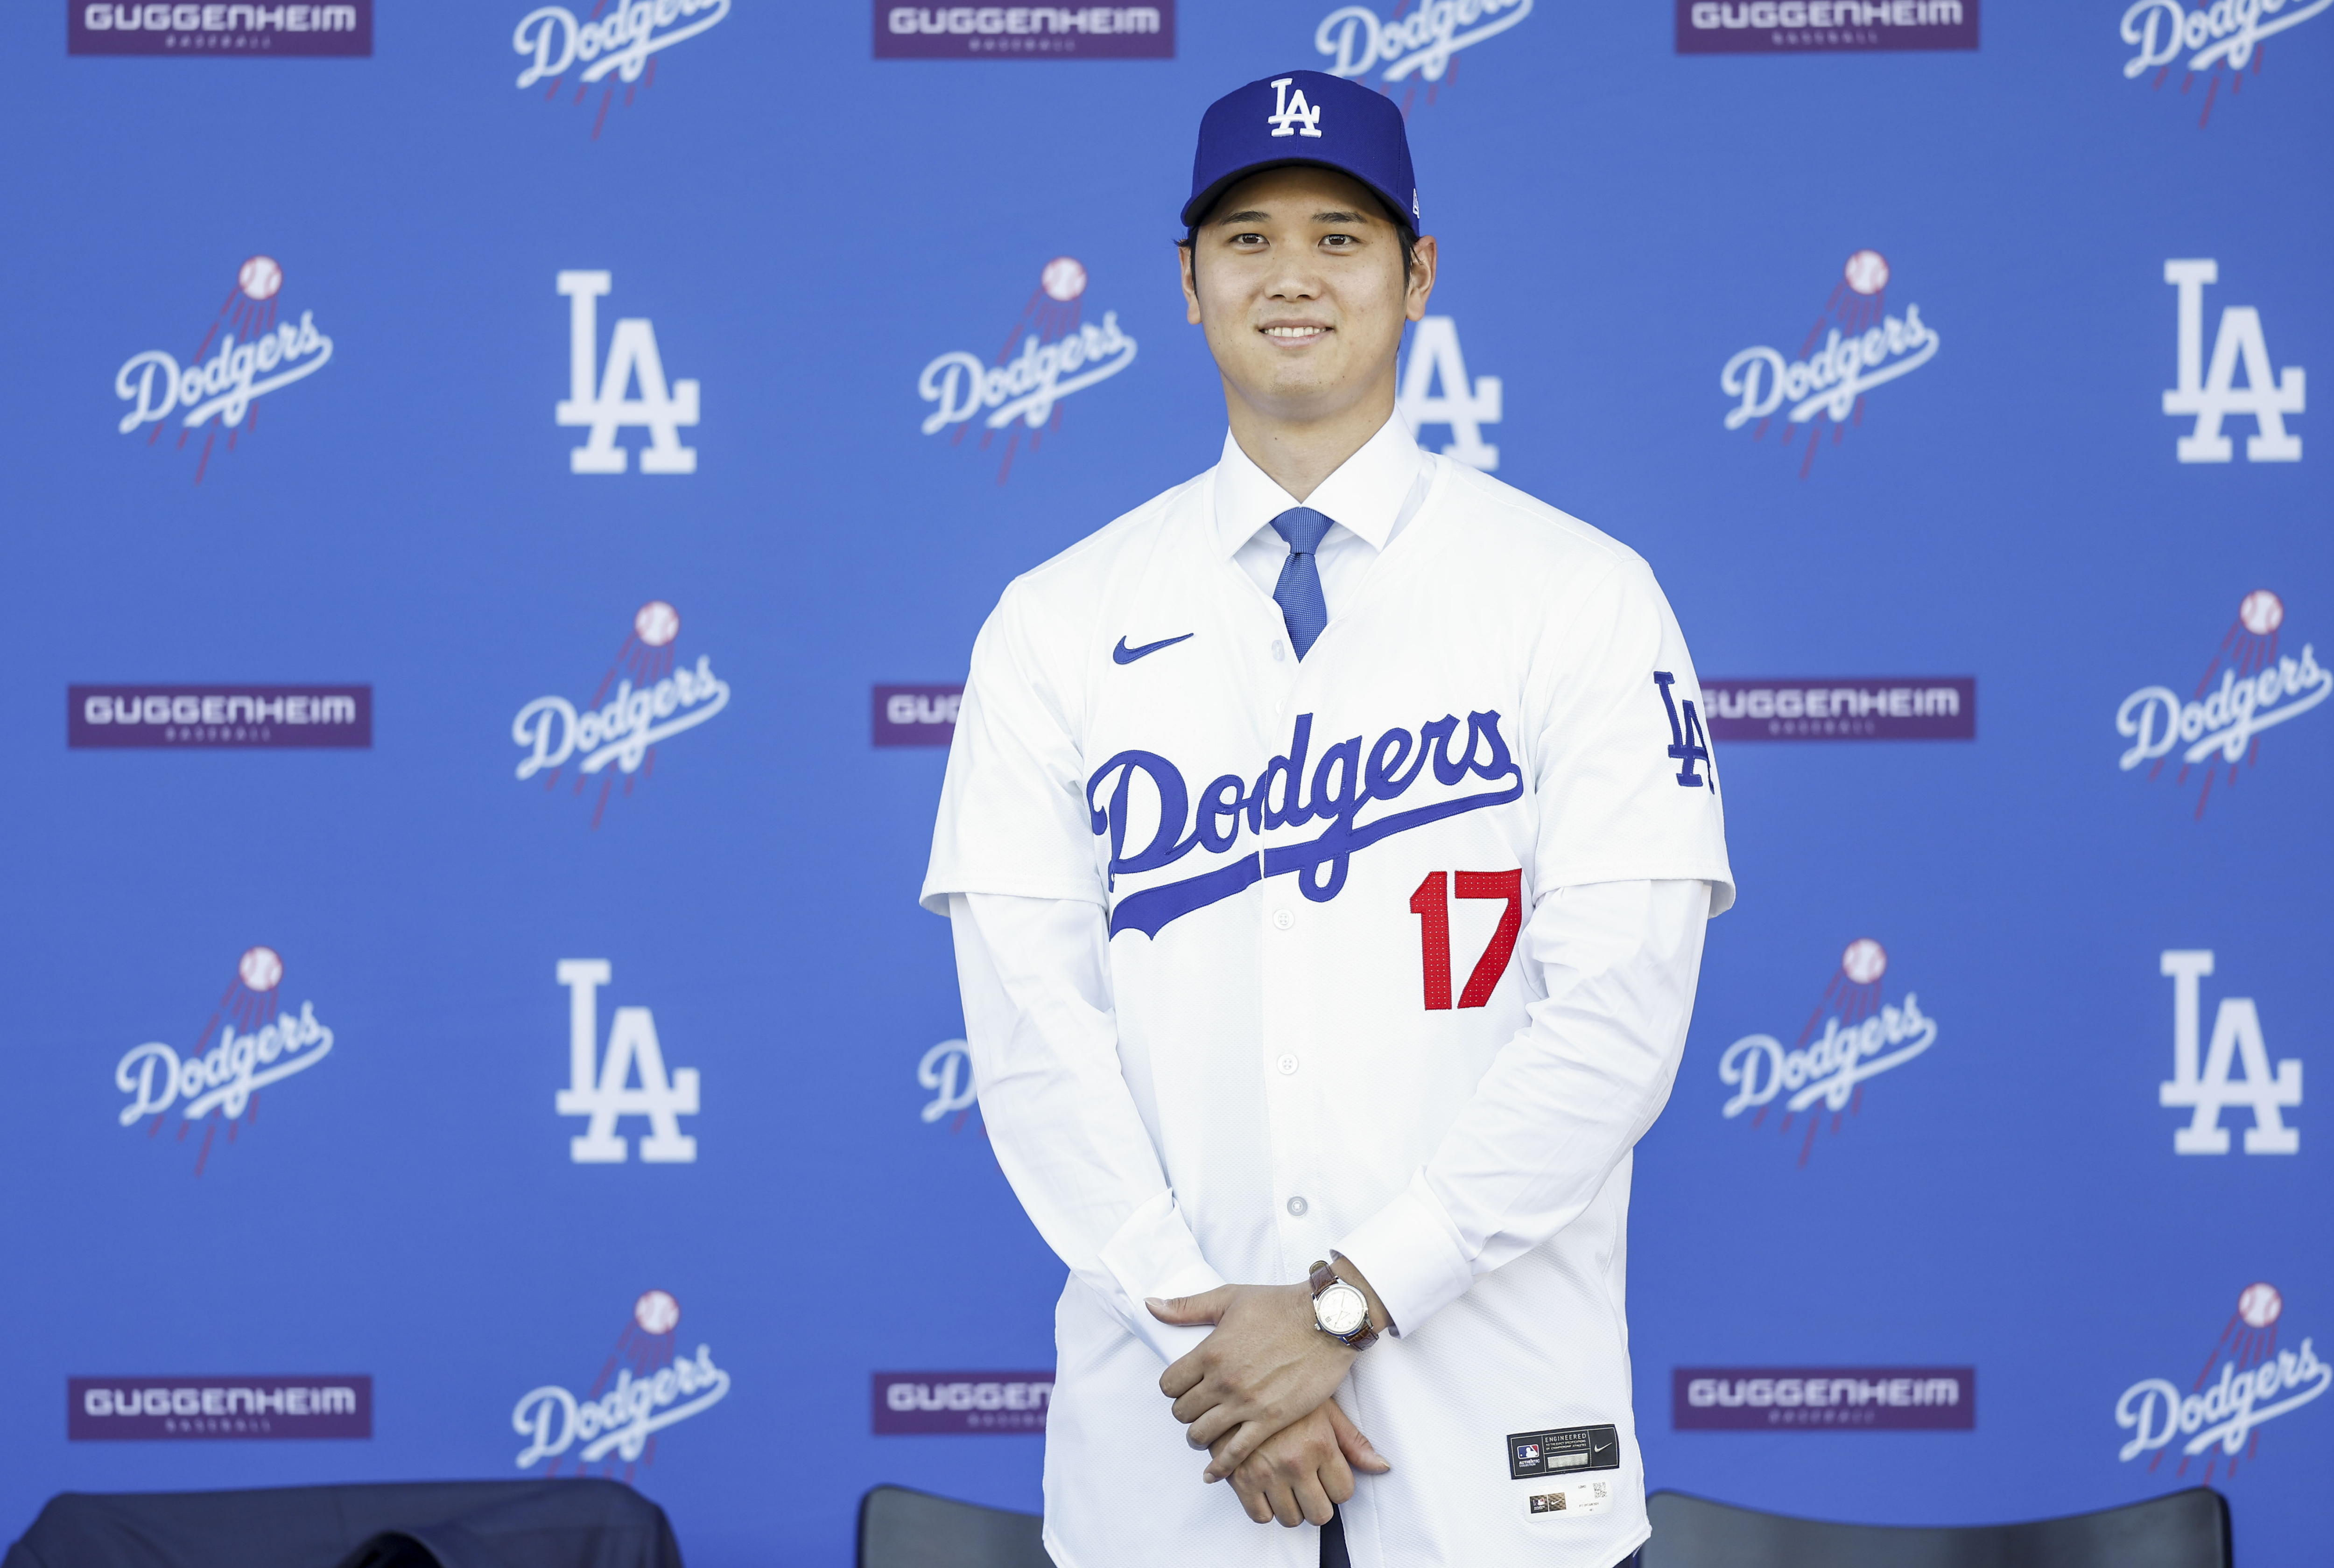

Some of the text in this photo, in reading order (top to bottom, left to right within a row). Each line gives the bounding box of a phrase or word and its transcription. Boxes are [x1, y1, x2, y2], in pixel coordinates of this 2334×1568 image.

[85, 3, 356, 32] GUGGENHEIM
[512, 0, 731, 89] Dodge
[889, 6, 1160, 34] GUGGENHEIM
[1315, 0, 1533, 82] Dodge
[1692, 0, 1962, 29] GUGGENHEIM
[2120, 0, 2334, 79] Dodg
[1268, 78, 1322, 138] LA
[114, 310, 334, 434] Dodgers
[555, 269, 701, 475] LA
[918, 311, 1138, 435] Dodgers
[1395, 315, 1503, 471] A
[1721, 304, 1940, 430] Dodgers
[2161, 258, 2306, 464] LA
[85, 696, 355, 725] GUGGENHEIM
[512, 655, 731, 780] Dodgers
[1653, 671, 1715, 795] LA
[2116, 644, 2334, 771] Dodgers
[1086, 710, 1524, 942] Dodgers
[1409, 868, 1523, 1010] 17
[115, 1001, 334, 1127] Dodgers
[555, 958, 701, 1164] LA
[1719, 994, 1937, 1118] Dodgers
[2159, 950, 2303, 1155] LA
[85, 1387, 355, 1416] GUGGENHEIM
[513, 1345, 730, 1468] Dodgers
[887, 1382, 1055, 1411] GUGGEN
[1545, 1433, 1586, 1443] ENGINEERED
[1688, 1378, 1959, 1407] GUGGENHEIM
[2115, 1338, 2333, 1462] Dodgers
